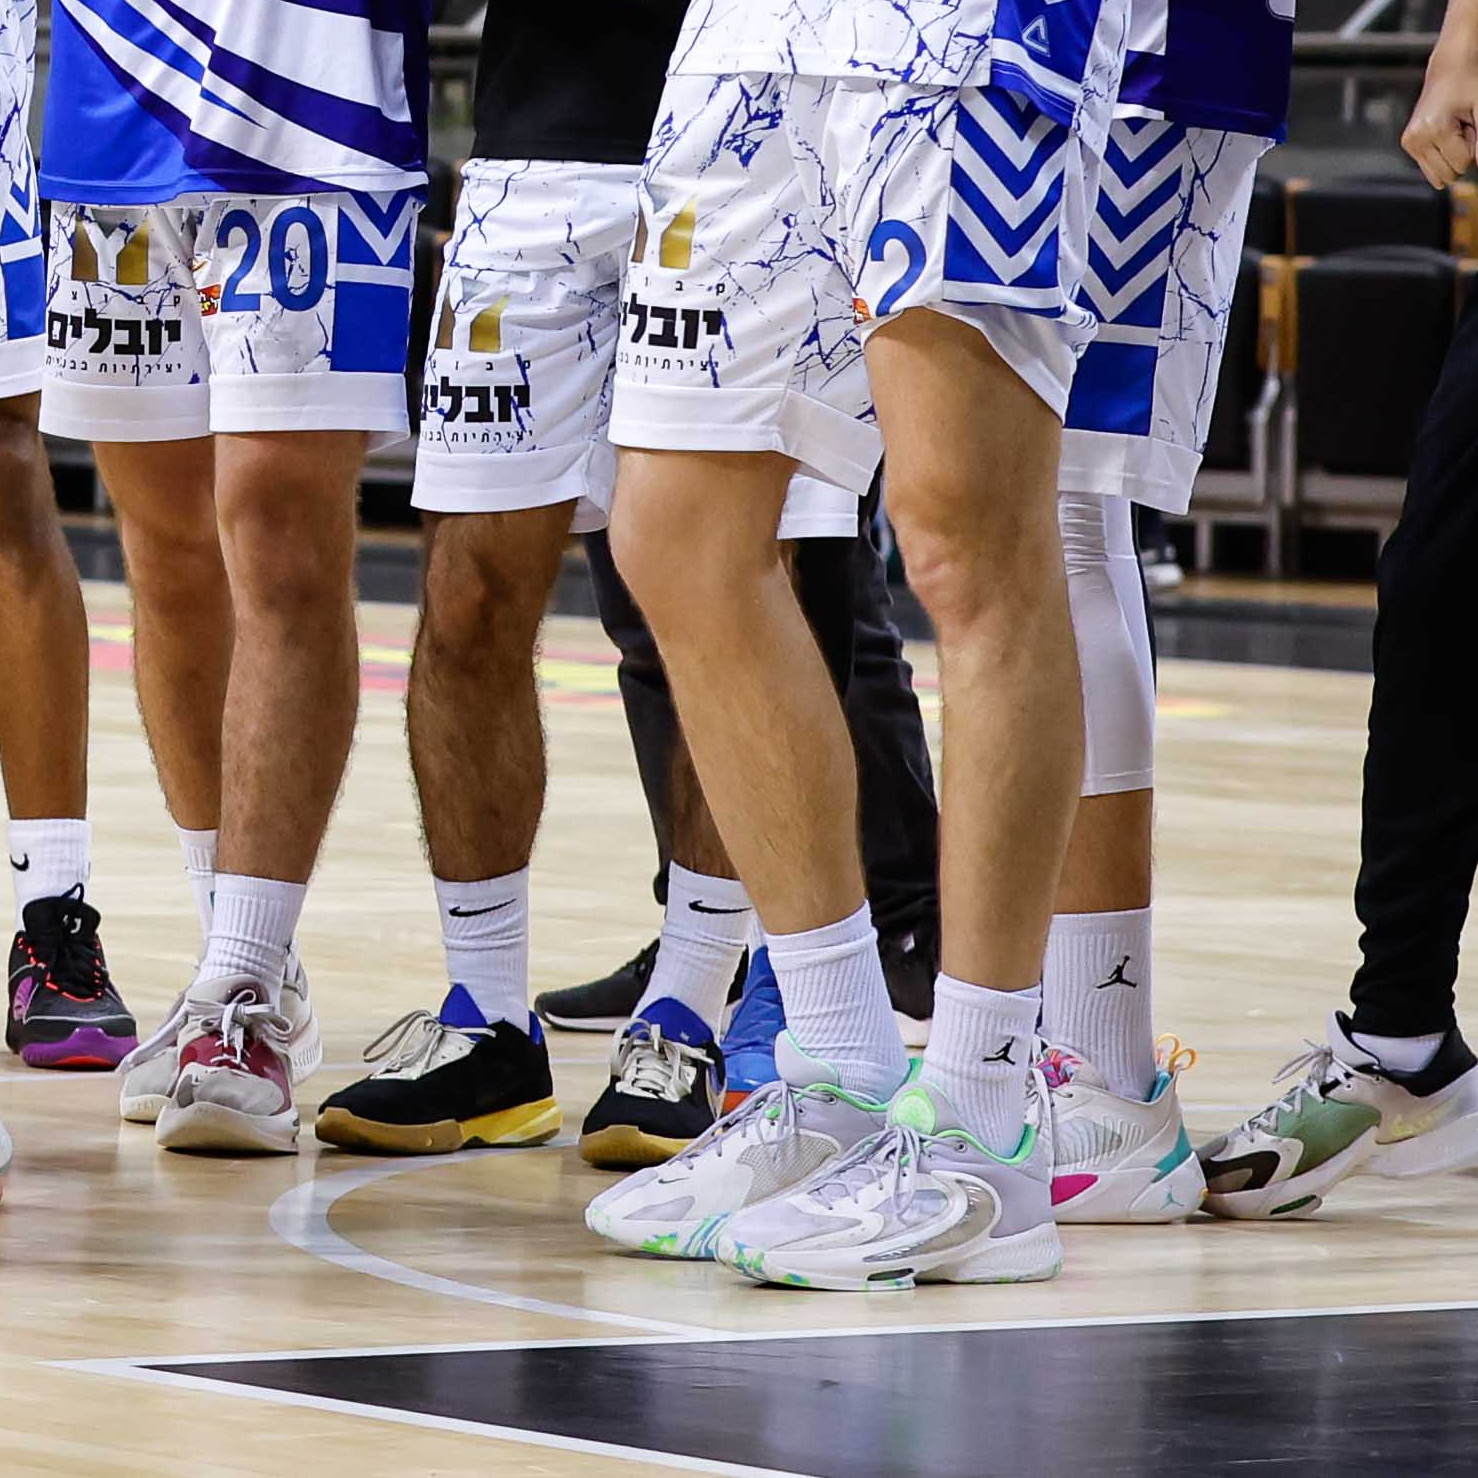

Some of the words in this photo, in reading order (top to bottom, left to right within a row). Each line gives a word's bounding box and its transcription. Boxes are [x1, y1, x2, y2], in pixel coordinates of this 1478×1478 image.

[216, 206, 328, 313] 20
[870, 219, 927, 318] 2
[71, 290, 181, 307] קבוצ
[619, 293, 724, 350] יובלי
[47, 307, 182, 355] יובלים
